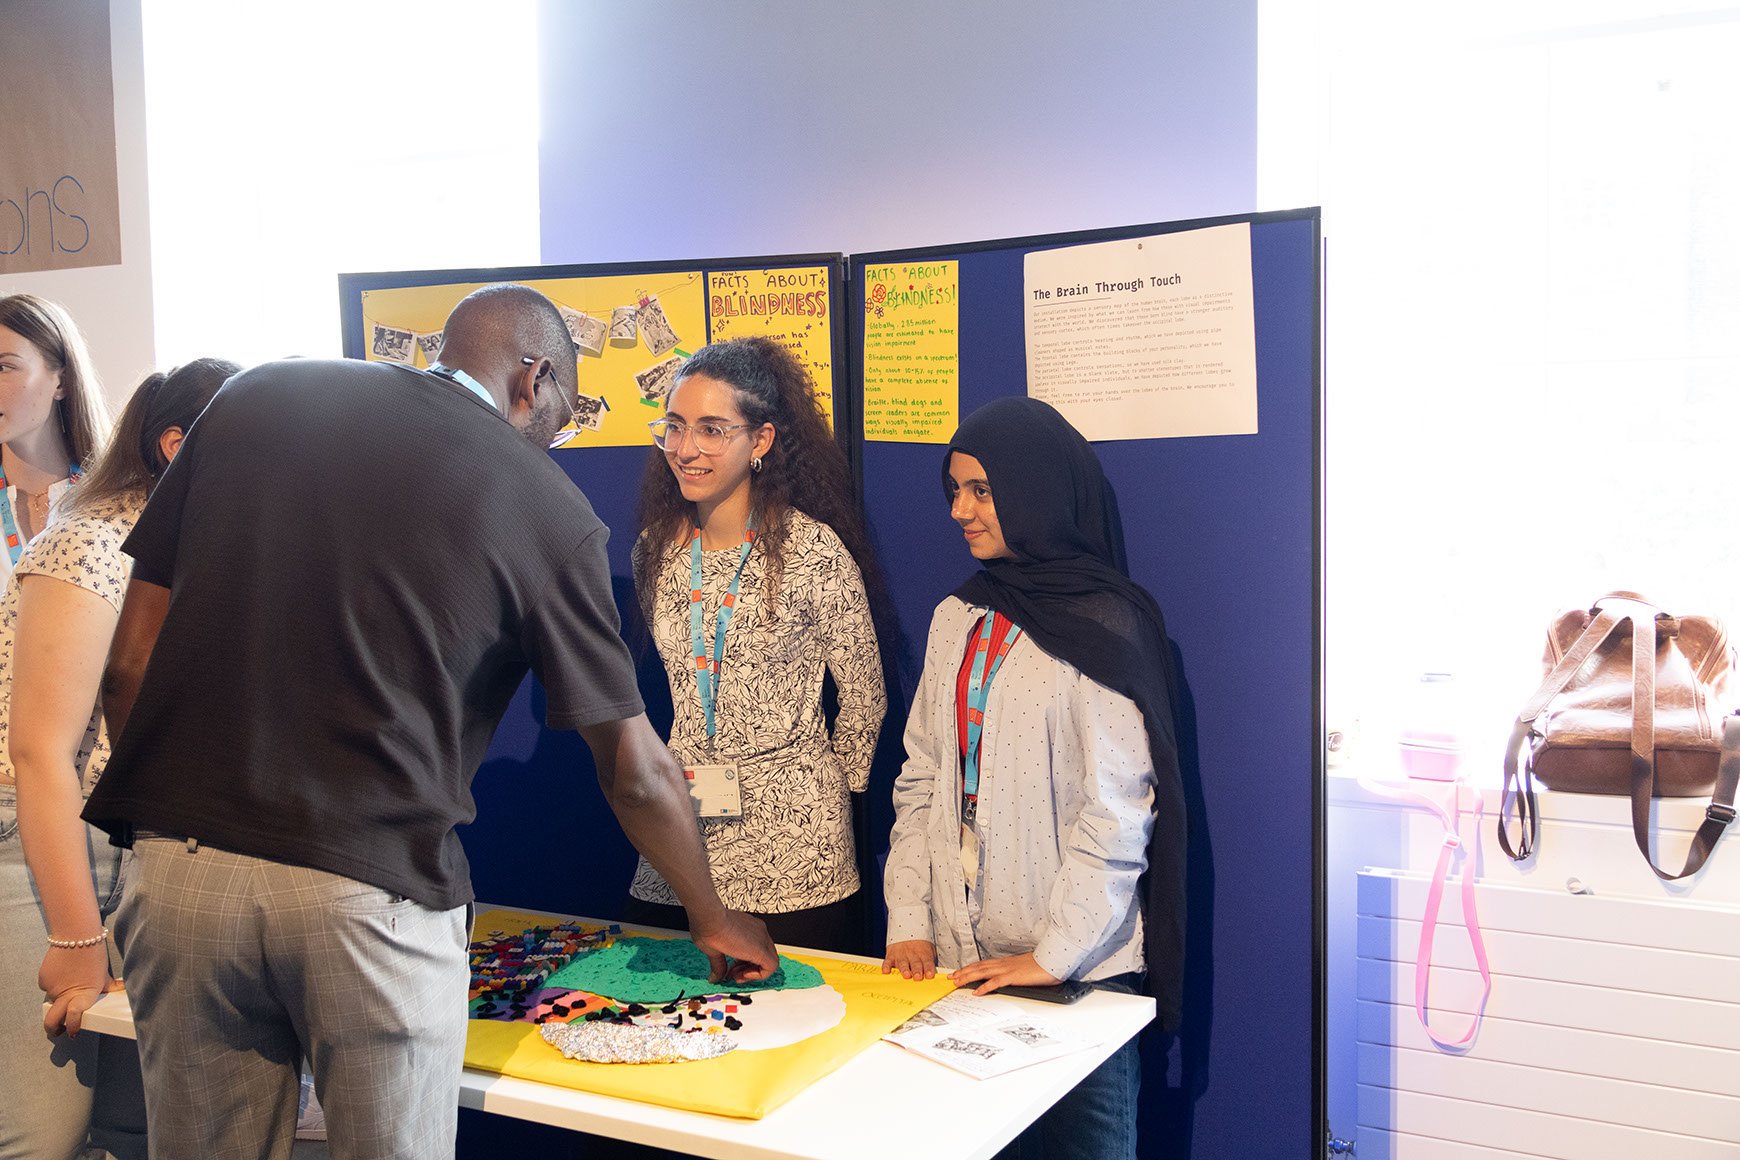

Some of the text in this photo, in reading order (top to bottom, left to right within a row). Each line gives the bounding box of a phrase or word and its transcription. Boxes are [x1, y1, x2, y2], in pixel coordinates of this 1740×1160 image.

[712, 274, 818, 288] FACTS ABOUT
[866, 265, 947, 282] FACTS ABOUT
[1033, 273, 1181, 300] The Brain Through Touch
[712, 290, 826, 318] BLINDNESS
[886, 284, 956, 310] BLINDNESS!
[911, 399, 927, 408] dogs
[886, 419, 908, 427] visually
